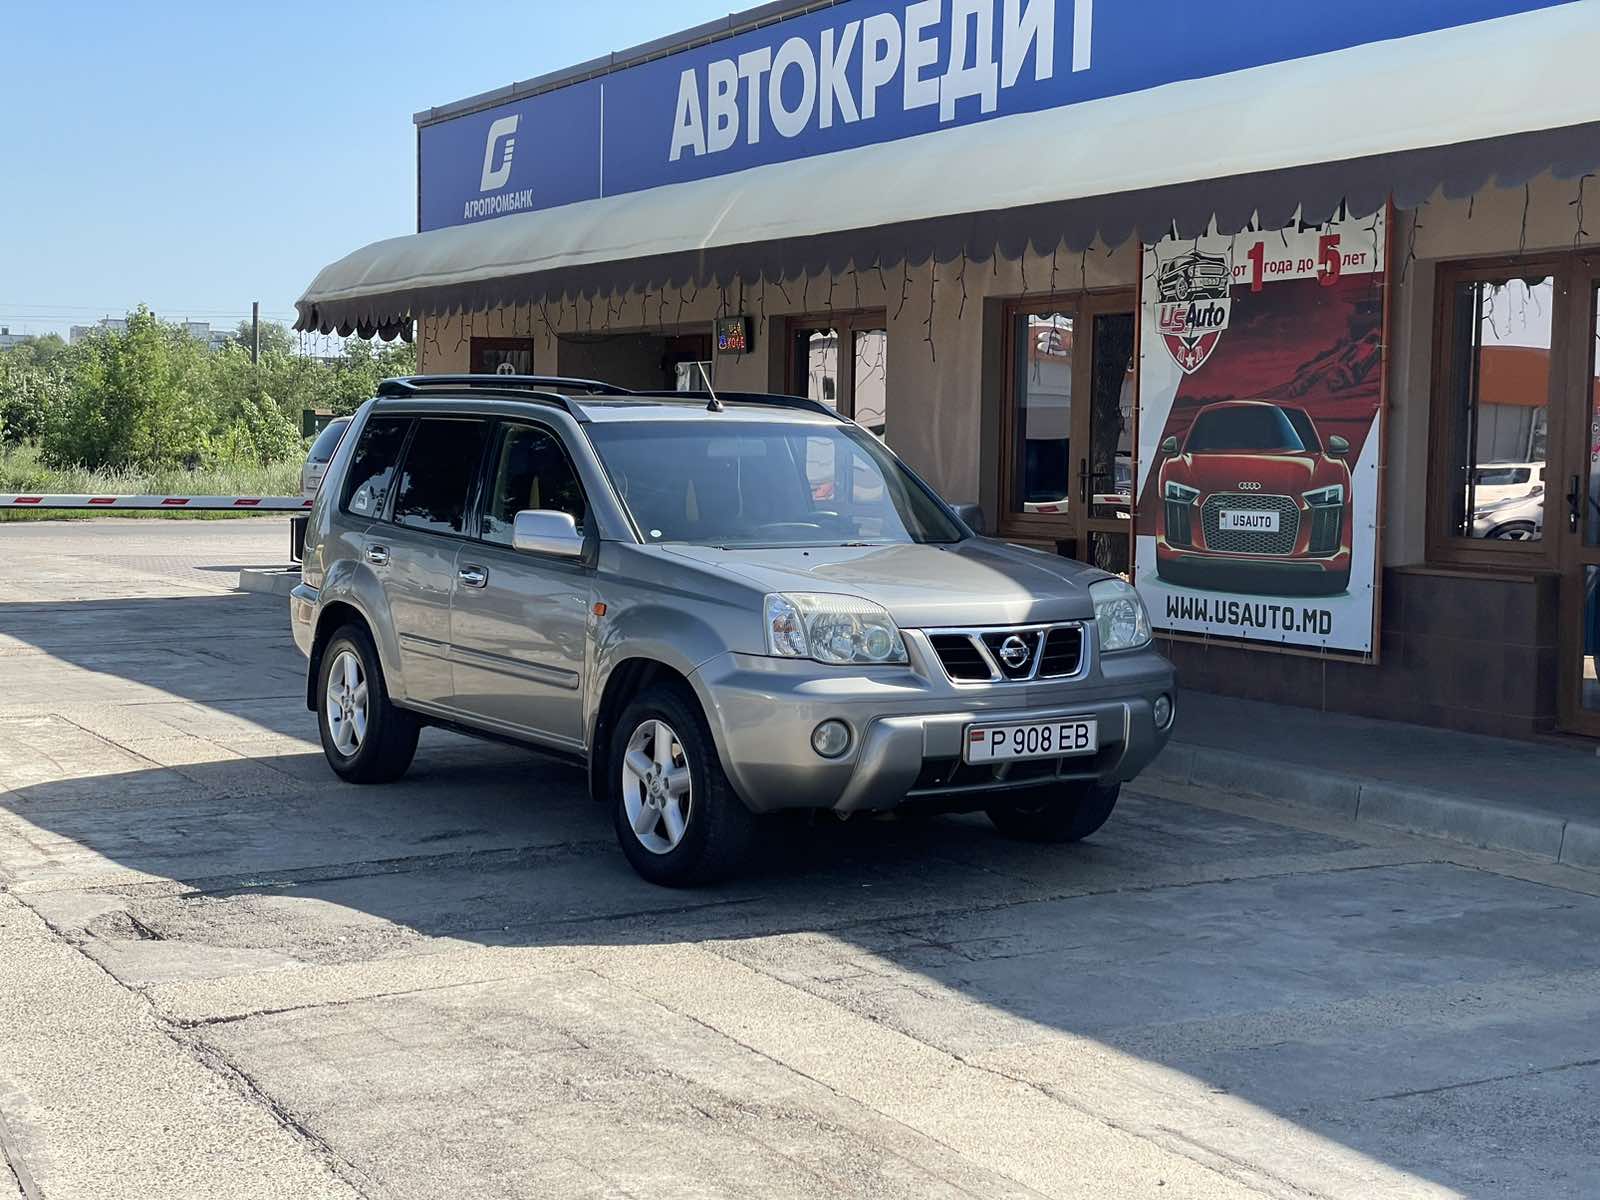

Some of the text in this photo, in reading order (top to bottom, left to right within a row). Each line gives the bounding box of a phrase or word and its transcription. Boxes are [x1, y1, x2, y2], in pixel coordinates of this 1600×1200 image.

[463, 189, 533, 219] АГРОПРОМБАНК
[1232, 233, 1367, 293] от 1 года до 5 лет
[1232, 514, 1272, 529] USAUTO
[1166, 594, 1332, 635] WWW.USAUTO.MD
[991, 723, 1089, 757] P 908 EB
